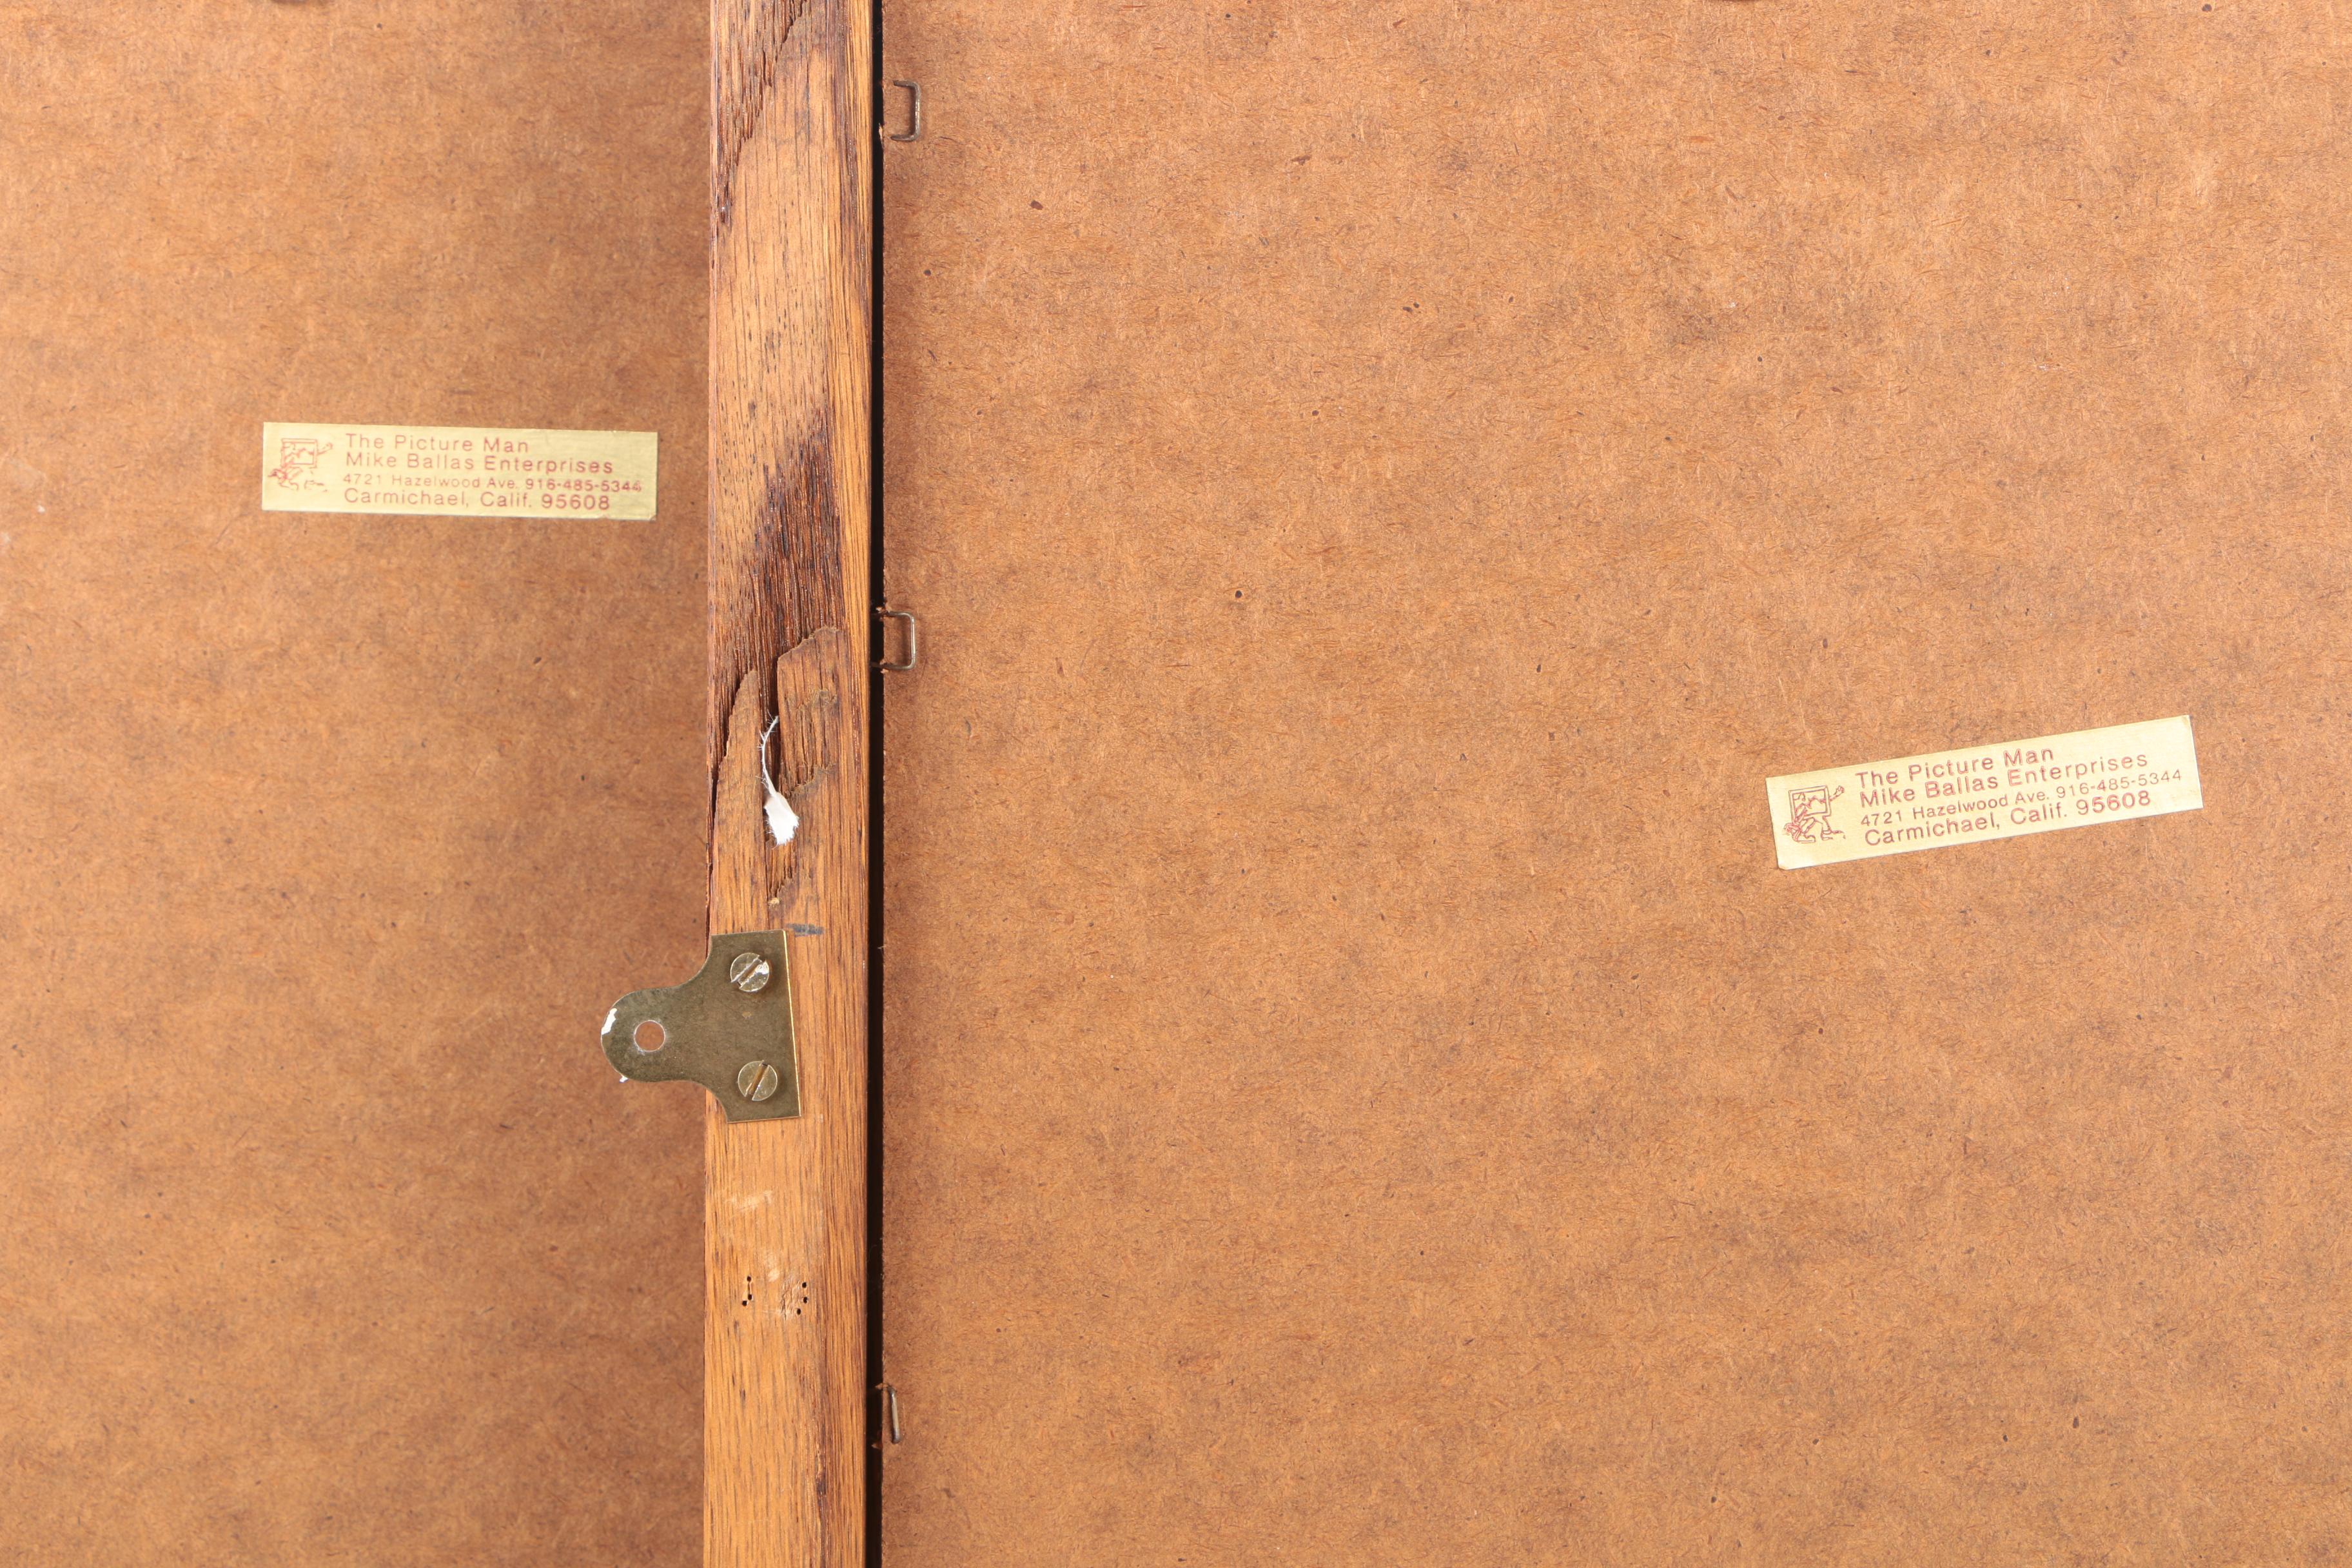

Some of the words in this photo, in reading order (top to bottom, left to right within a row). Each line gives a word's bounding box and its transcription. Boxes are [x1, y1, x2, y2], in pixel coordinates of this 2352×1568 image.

[346, 433, 384, 449] The
[395, 435, 473, 451] Picture
[484, 437, 529, 453] Man
[346, 453, 397, 467] Mike
[407, 453, 474, 469] Ballas
[485, 456, 612, 475] Enterprises
[343, 473, 382, 485] 4721
[392, 475, 480, 488] Hazelwood
[487, 478, 518, 489] Ave.
[525, 478, 642, 493] 916-485-5344
[344, 487, 469, 508] Carmichael,
[480, 492, 532, 508] Calif.
[541, 493, 610, 510] 95608
[1855, 770, 1899, 789] The
[1908, 757, 1994, 781] Picture
[2003, 748, 2054, 767] Man
[1860, 788, 1915, 808] Mike
[1925, 776, 1998, 798] Ballas
[2008, 754, 2148, 787] Enterprises
[1861, 810, 1902, 827] 4721
[1913, 794, 2008, 820] Hazelwood
[2015, 790, 2050, 805] Ave.
[2056, 769, 2182, 799] 916-485-5344
[1865, 811, 1999, 846] Carmichael,
[2010, 801, 2068, 825] Calif.
[2075, 790, 2151, 816] 95608
